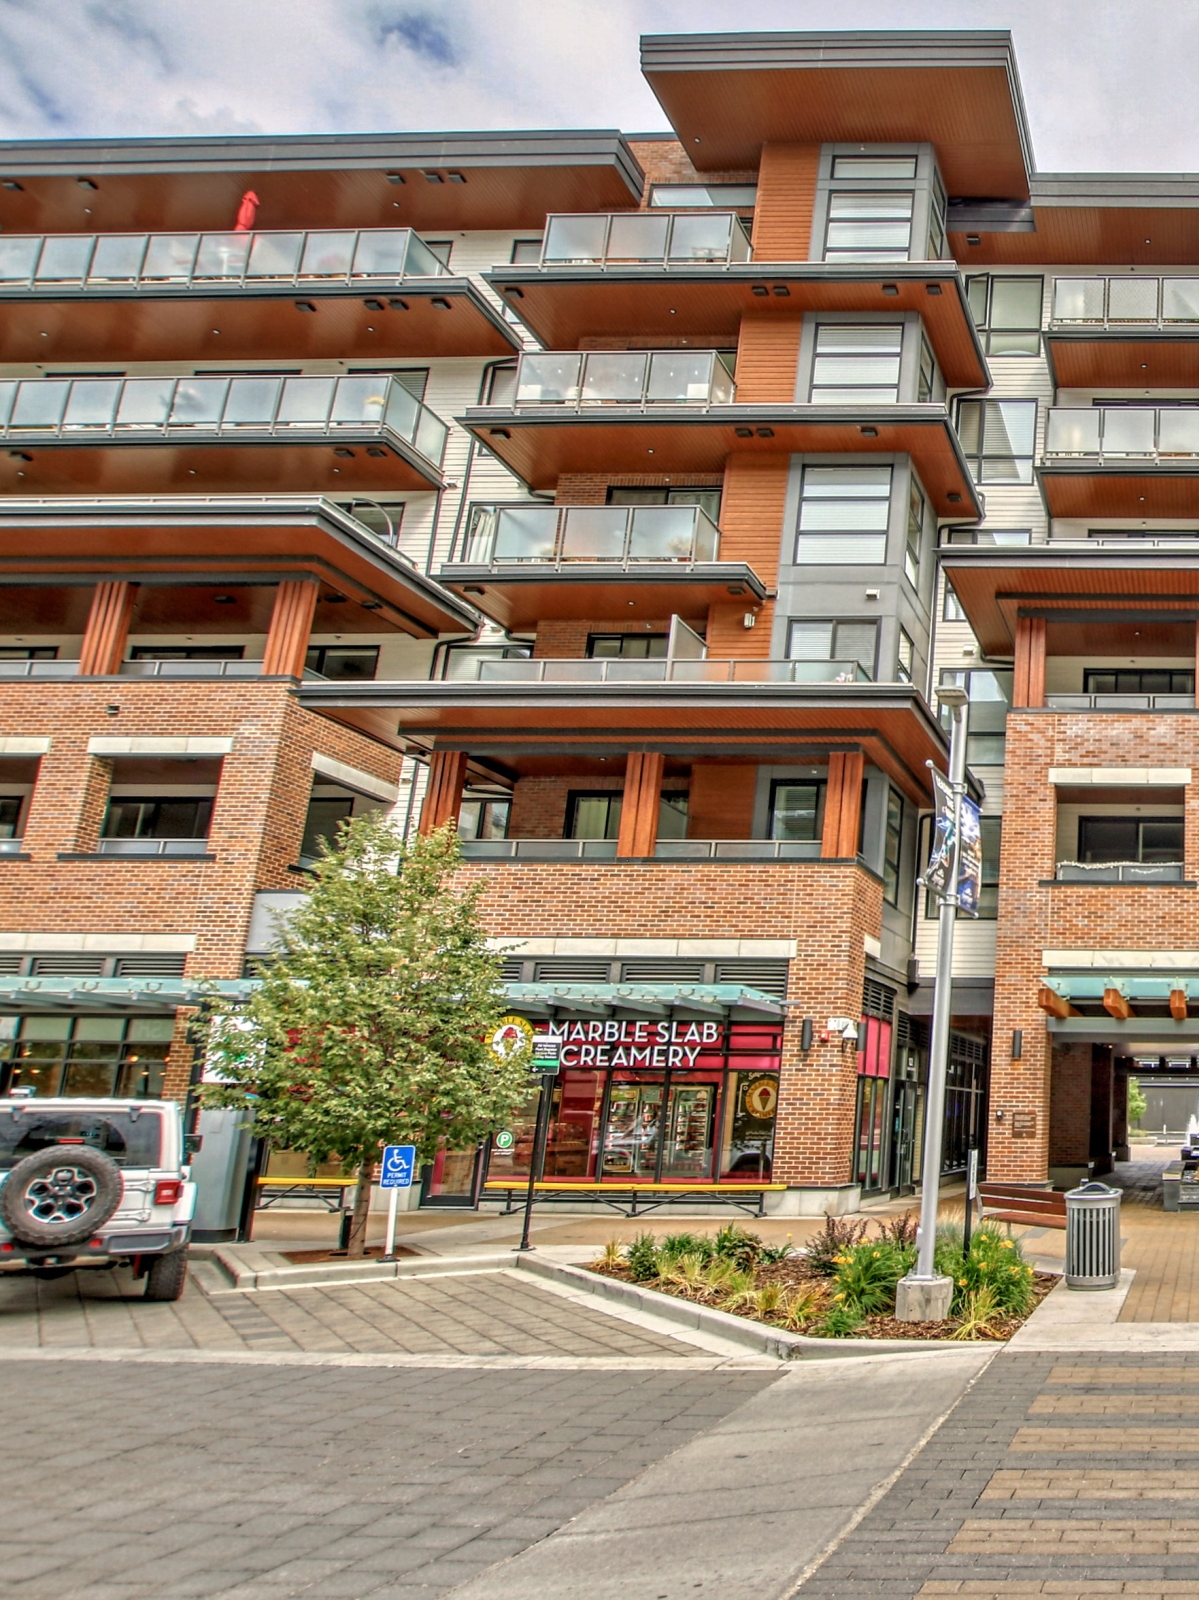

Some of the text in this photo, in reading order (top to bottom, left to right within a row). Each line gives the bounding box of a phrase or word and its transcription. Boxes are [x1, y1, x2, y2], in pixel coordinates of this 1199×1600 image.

[548, 1021, 718, 1043] MARBLE SLAB
[561, 1045, 702, 1067] CREAMERY
[500, 1135, 509, 1146] P
